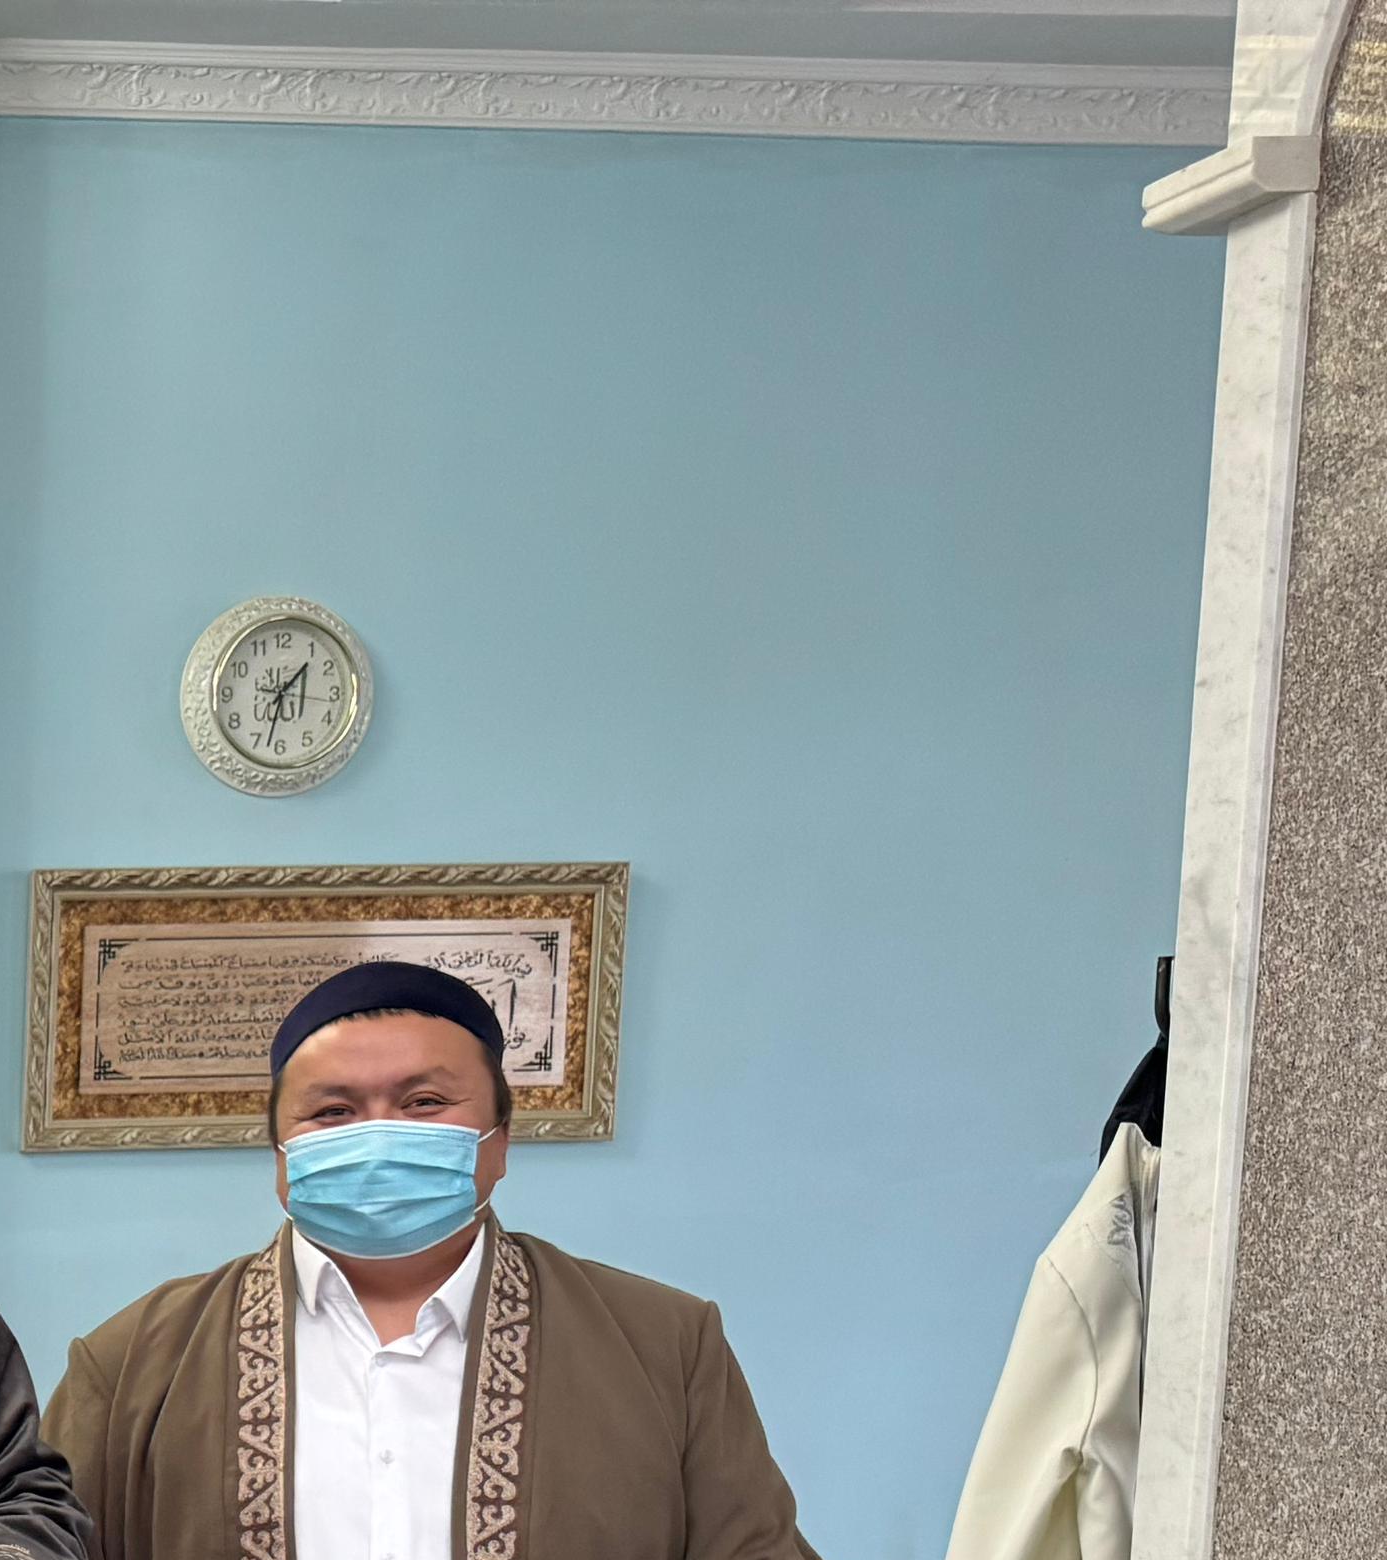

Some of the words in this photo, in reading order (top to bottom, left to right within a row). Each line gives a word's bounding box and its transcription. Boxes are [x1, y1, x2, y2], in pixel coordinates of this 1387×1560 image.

[251, 641, 267, 656] 11
[273, 633, 292, 649] 12
[307, 641, 315, 658] 1
[231, 662, 249, 678] 10
[322, 660, 335, 675] 2
[220, 687, 233, 704] 9
[329, 685, 340, 702] 3
[228, 712, 241, 730] 8
[321, 710, 333, 726] 4
[250, 733, 262, 749] 7
[274, 739, 286, 756] 6
[302, 731, 313, 748] 5
